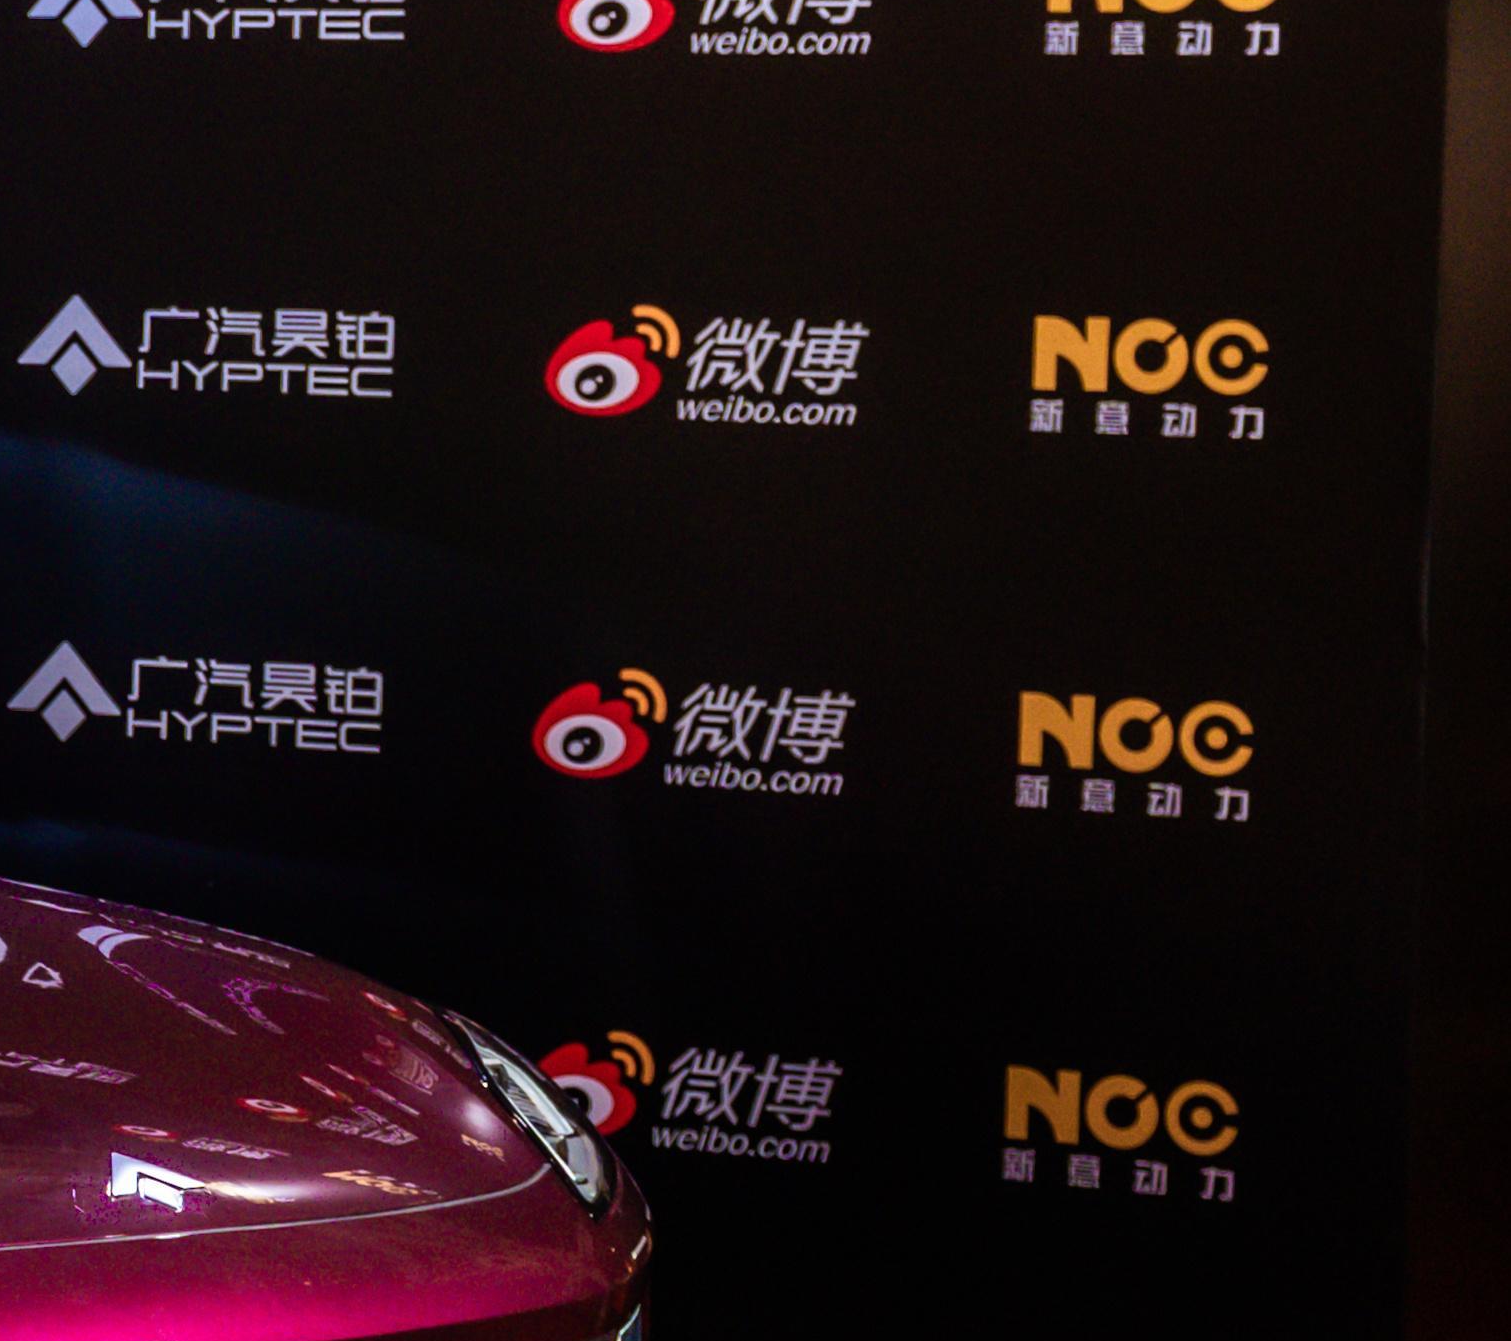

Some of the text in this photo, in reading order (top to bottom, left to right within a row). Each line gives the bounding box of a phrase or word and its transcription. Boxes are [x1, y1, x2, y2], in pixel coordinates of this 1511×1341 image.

[148, 9, 405, 40] HYPTEC
[691, 27, 871, 55] weibo.com
[1047, 21, 1279, 55] 新意动力
[687, 318, 869, 395] 微博
[1033, 318, 1268, 395] NOC
[138, 360, 392, 397] HYPTEC
[1031, 400, 1264, 439] 新意动力
[128, 656, 383, 715] 广汽昊铂
[127, 708, 380, 752] HYPTEC
[675, 684, 855, 763] 微博
[1020, 693, 1253, 781] NOC
[665, 762, 843, 795] weibo.com
